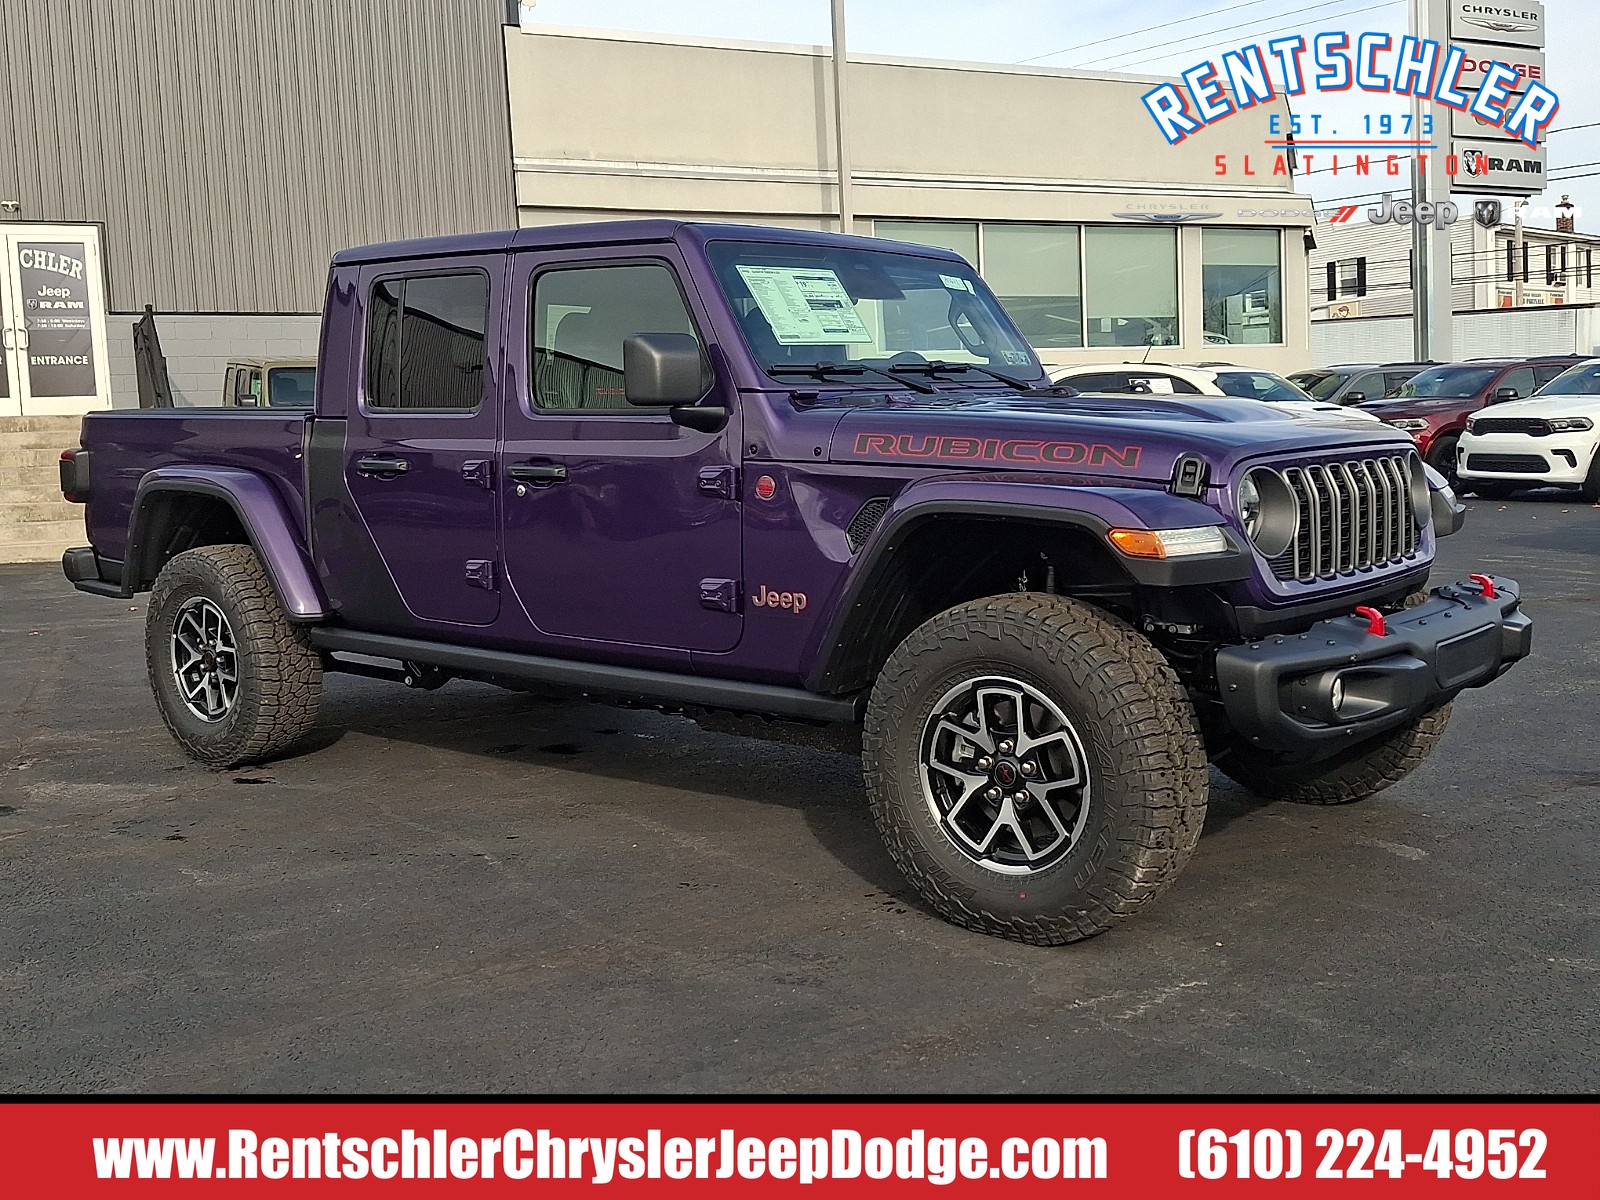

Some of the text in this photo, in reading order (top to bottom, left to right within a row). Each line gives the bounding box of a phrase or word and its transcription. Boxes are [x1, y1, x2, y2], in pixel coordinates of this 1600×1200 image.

[1462, 4, 1538, 20] CHRYSLER
[1488, 157, 1542, 174] RAM
[19, 248, 83, 280] CHLER
[37, 285, 71, 299] Jeep
[39, 301, 84, 309] RAM
[30, 355, 89, 366] ENTRANCE
[853, 432, 1143, 469] RUBICON
[751, 584, 808, 614] Jeep
